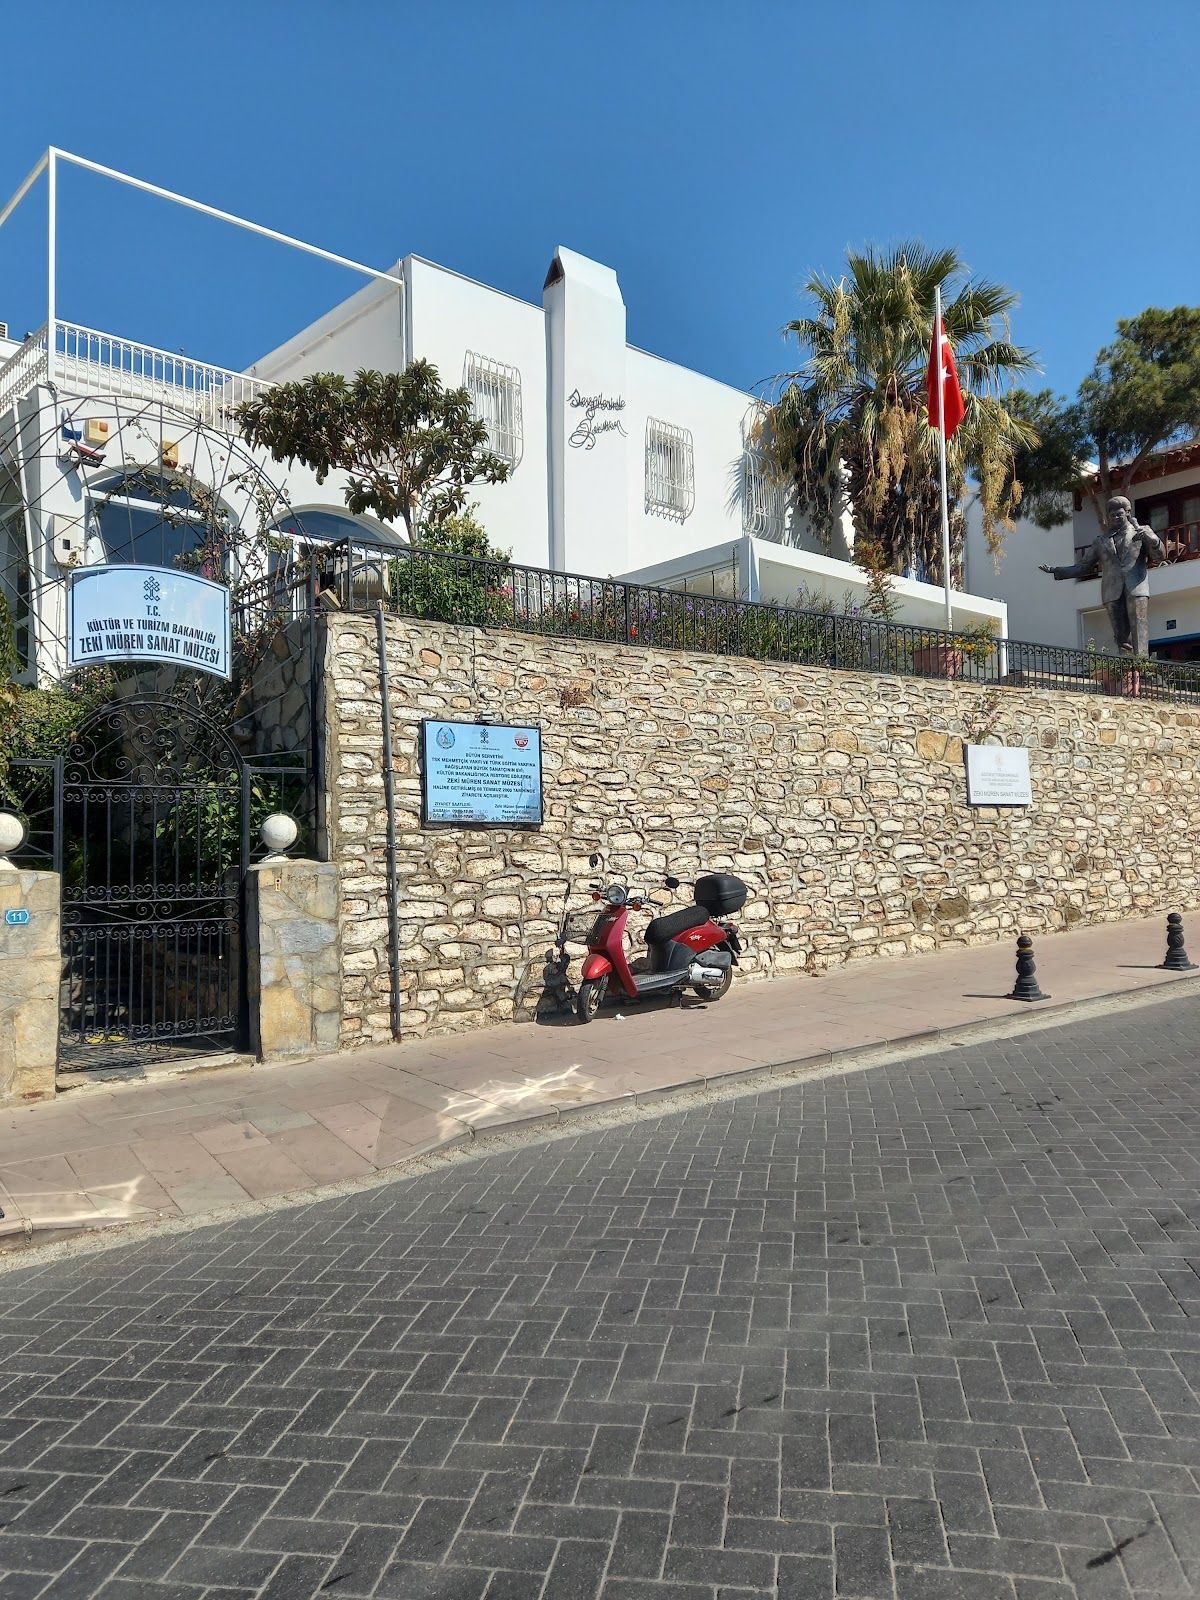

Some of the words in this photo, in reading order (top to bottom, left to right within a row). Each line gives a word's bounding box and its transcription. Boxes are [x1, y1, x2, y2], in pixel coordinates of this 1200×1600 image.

[146, 604, 161, 617] T.C.
[86, 618, 120, 632] KÜLTÜR
[123, 618, 134, 630] VE
[136, 618, 170, 632] TURİZM
[172, 624, 216, 644] BAKANLIĞI
[79, 632, 103, 654] ZEKİ
[106, 630, 144, 650] MÜREN
[147, 635, 180, 654] SANAT
[183, 640, 220, 664] MÜZESİ
[11, 912, 22, 921] 11
